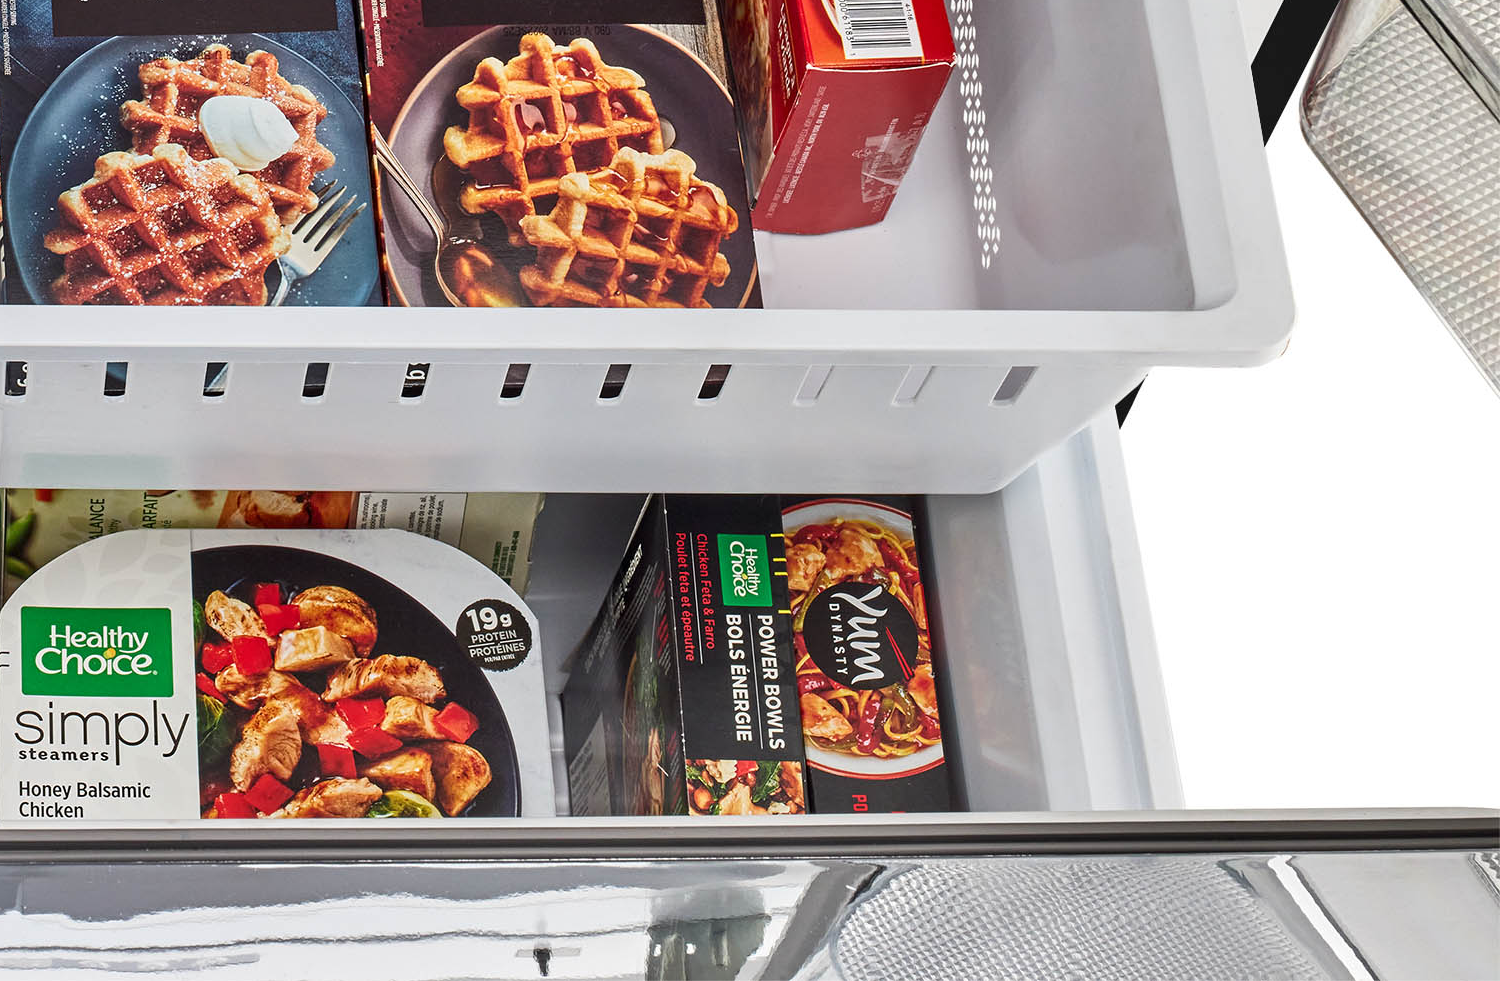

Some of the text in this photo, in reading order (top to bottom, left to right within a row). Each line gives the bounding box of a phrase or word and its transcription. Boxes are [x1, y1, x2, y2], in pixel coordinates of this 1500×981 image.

[696, 533, 716, 649] Chicken Feta & Farro
[729, 540, 748, 598] Choice
[745, 548, 761, 596] Healthy
[675, 532, 695, 662] Poulet feta et épeautre
[35, 647, 155, 676] Choice
[49, 624, 149, 654] Healthy
[469, 642, 526, 658] PROTÉINES
[471, 630, 517, 644] PROTEIN
[828, 603, 849, 675] DYNASTY
[830, 585, 888, 685] Yum
[726, 614, 753, 742] BOLS ÉNERGIE
[757, 614, 786, 750] POWER BOWLS
[14, 700, 190, 766] simply
[18, 748, 110, 762] steamers
[19, 781, 151, 801] Honey Balsamic
[19, 802, 84, 819] Chicken
